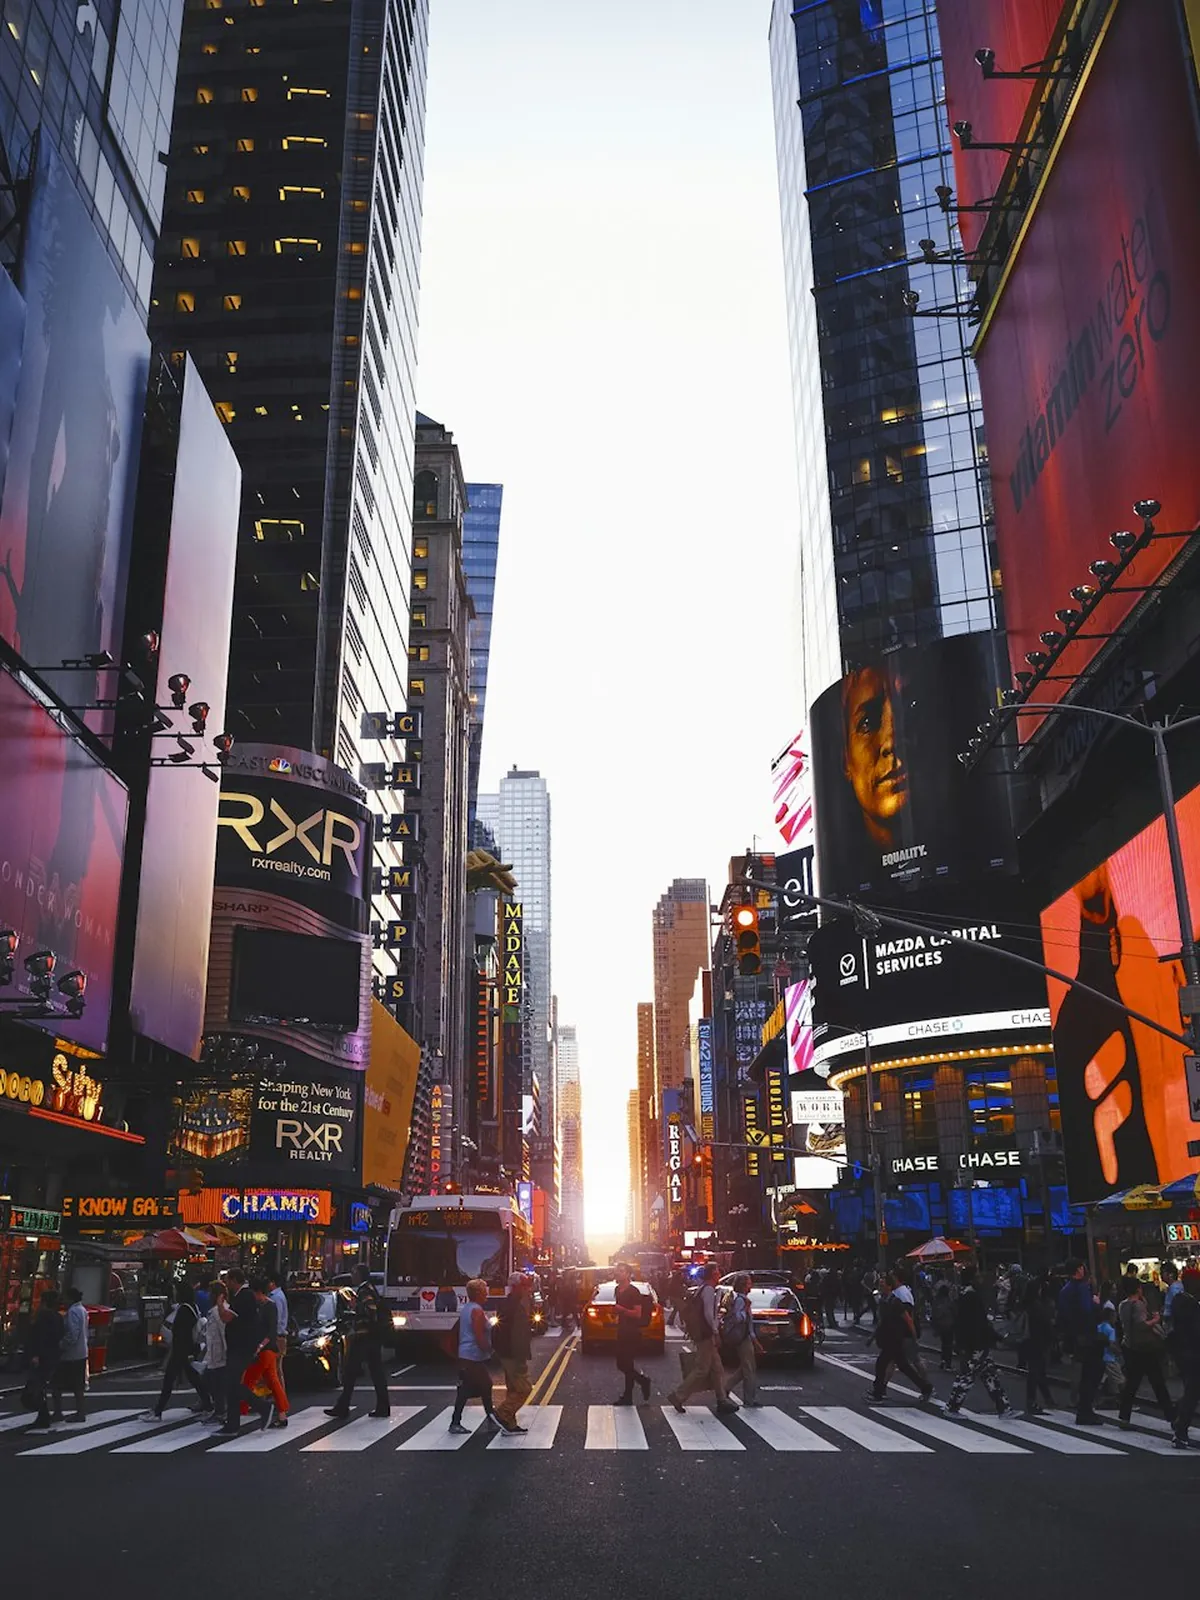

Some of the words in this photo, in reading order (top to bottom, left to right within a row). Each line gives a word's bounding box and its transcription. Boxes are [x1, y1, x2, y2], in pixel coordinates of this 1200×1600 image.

[1099, 268, 1171, 435] zero
[217, 791, 361, 878] RXR
[881, 844, 928, 867] EQUALITY.
[252, 857, 332, 881] rxrrealty.com
[504, 903, 522, 1004] MADAME
[875, 936, 926, 958] MAZDA
[876, 950, 943, 976] SERVICES
[907, 1020, 950, 1036] CHASE
[311, 1083, 334, 1097] New
[335, 1085, 352, 1100] York
[700, 1073, 713, 1112] STUDIOS
[769, 1070, 782, 1127] VICTORY
[258, 1096, 278, 1110] for
[279, 1098, 299, 1112] the
[301, 1100, 322, 1115] 21st
[322, 1103, 354, 1122] Century
[799, 1102, 842, 1111] WORK
[275, 1119, 343, 1152] RXR
[771, 1133, 785, 1161] NW
[290, 1150, 333, 1161] REALTY
[668, 1124, 682, 1202] REGAL
[891, 1156, 939, 1173] CHASE
[959, 1150, 1021, 1169] CHASE
[766, 1184, 796, 1196] SKCHERS
[78, 1197, 127, 1216] KNOW
[222, 1194, 320, 1219] CHAMPS
[1168, 1224, 1200, 1241] SODA
